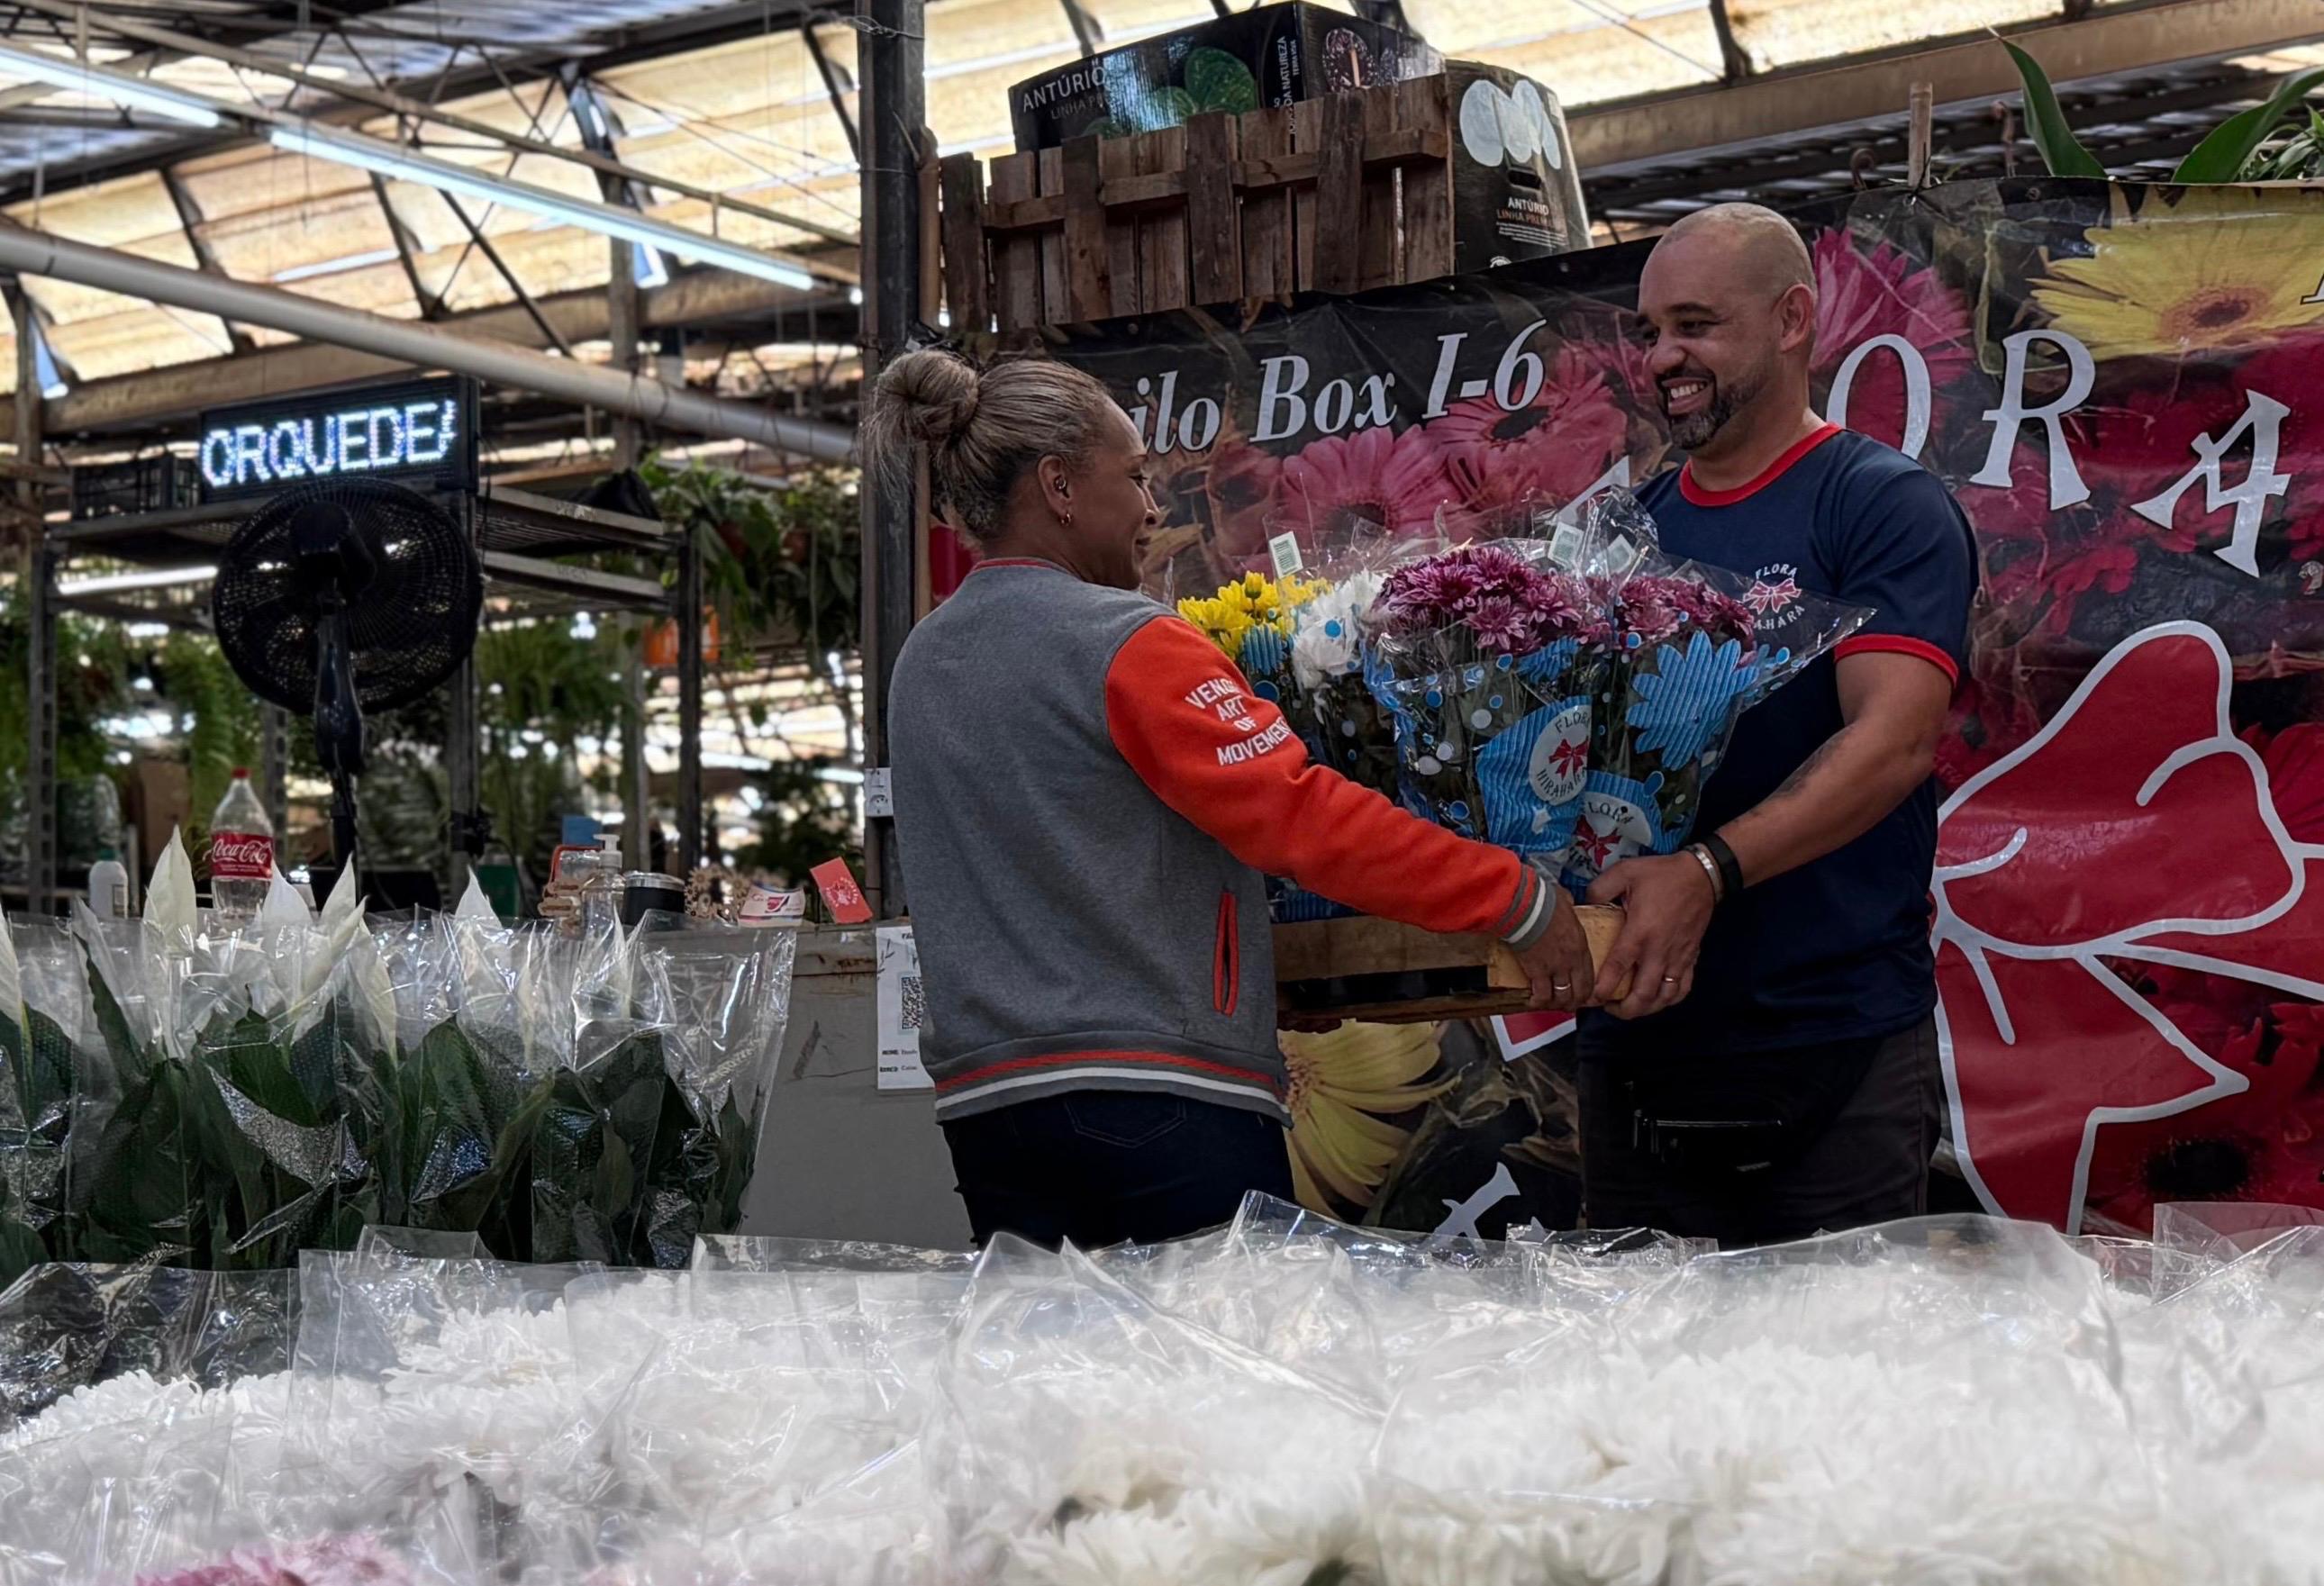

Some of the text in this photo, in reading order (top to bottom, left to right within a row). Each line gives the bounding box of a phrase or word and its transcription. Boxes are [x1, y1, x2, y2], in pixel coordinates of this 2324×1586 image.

[1277, 36, 1291, 90] NATUREZA
[1022, 66, 1106, 113] ANTÚRIO
[1129, 319, 1548, 455] ilo Box I-6
[1826, 329, 2292, 579] ORA
[1755, 563, 1798, 580] FLORA
[1753, 605, 1805, 630] AHARA
[1215, 694, 1247, 721] ART
[1234, 716, 1256, 731] OF
